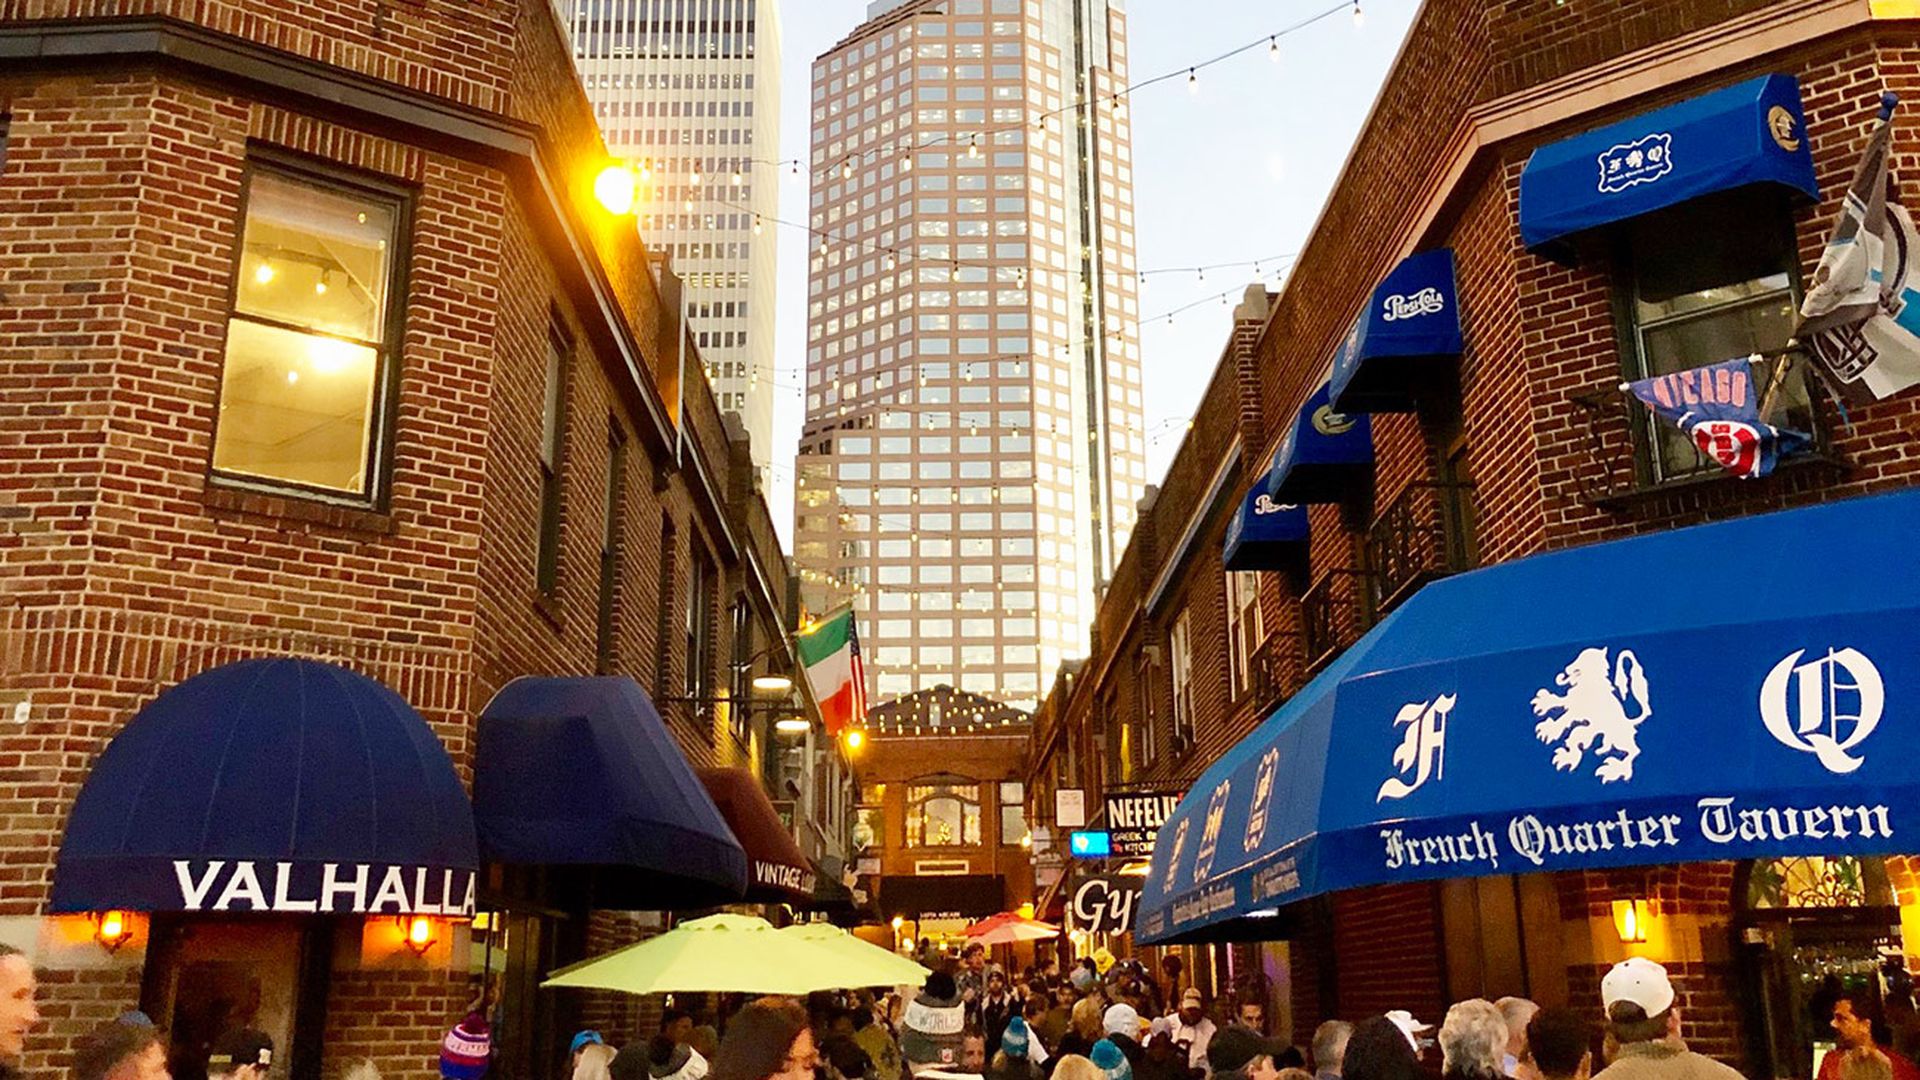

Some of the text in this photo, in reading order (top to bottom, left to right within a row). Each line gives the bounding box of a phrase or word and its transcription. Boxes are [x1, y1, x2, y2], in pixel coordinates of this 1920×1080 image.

[1759, 646, 1885, 775] Q
[1380, 797, 1894, 869] French Quarter Tavern
[173, 860, 476, 916] VALHALLA
[755, 860, 802, 889] VINTAGE
